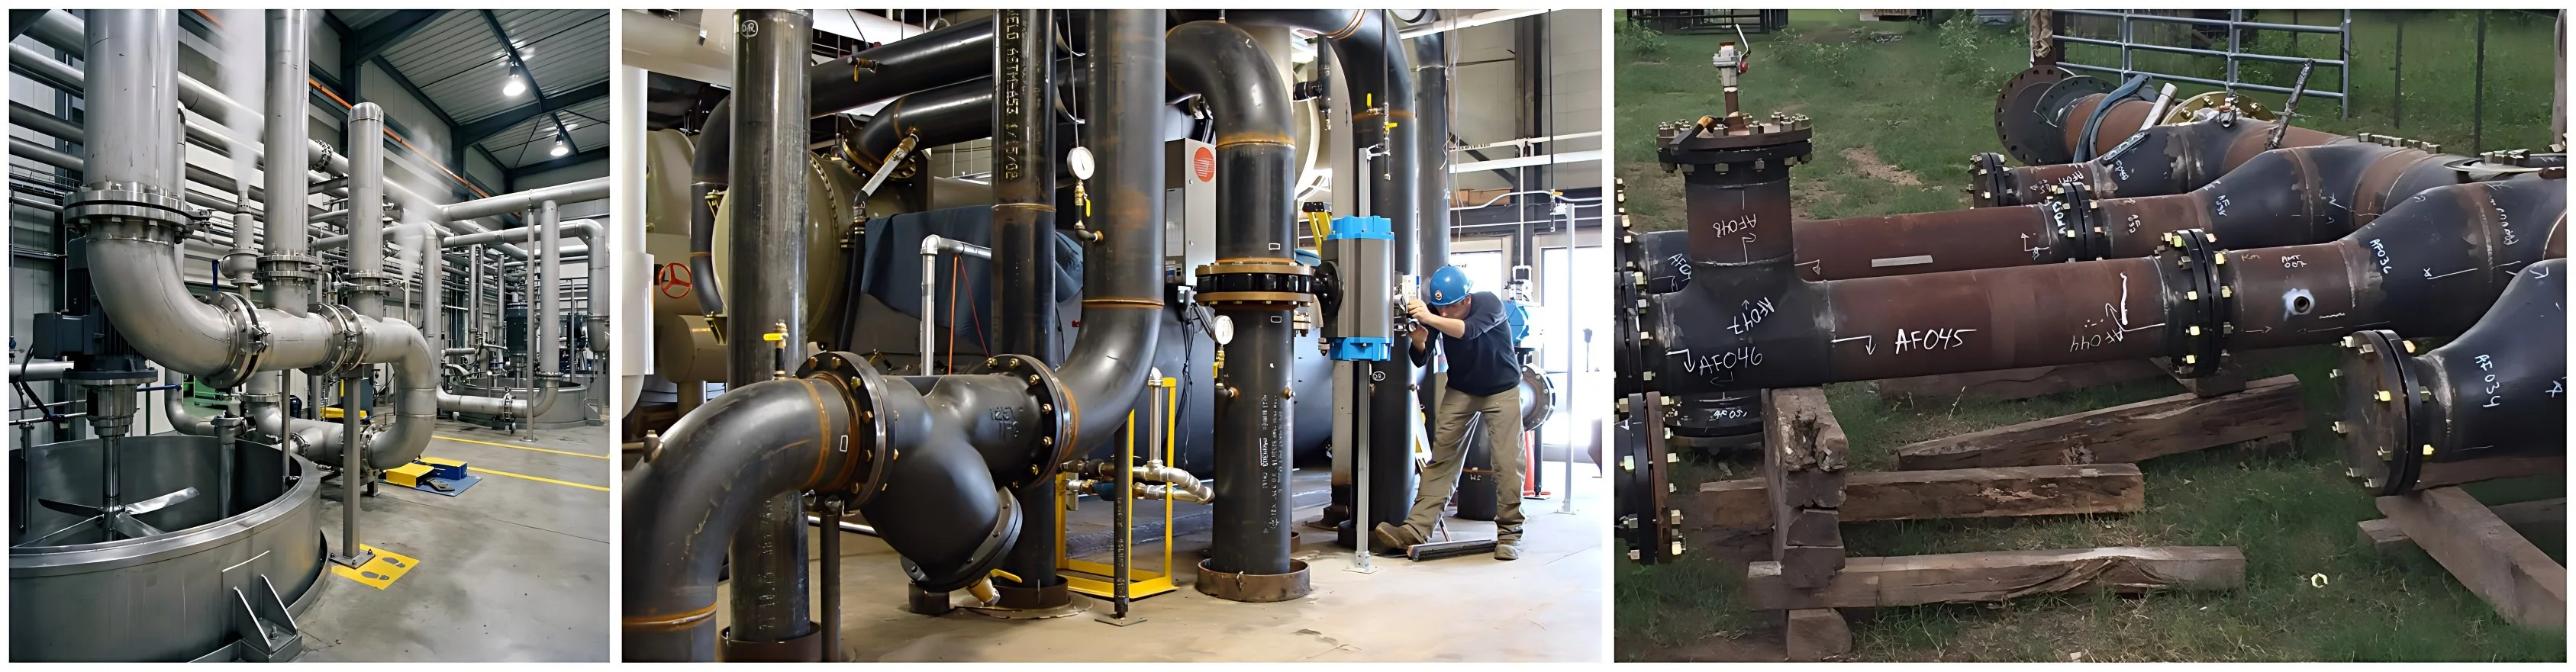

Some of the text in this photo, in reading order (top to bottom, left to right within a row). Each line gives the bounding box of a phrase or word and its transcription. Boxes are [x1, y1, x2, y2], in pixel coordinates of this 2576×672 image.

[1713, 214, 1756, 238] AF048
[1726, 296, 1775, 335] AF047
[1895, 328, 1978, 355] AF045
[1699, 346, 1763, 376] AF046
[2474, 354, 2501, 408] AF034
